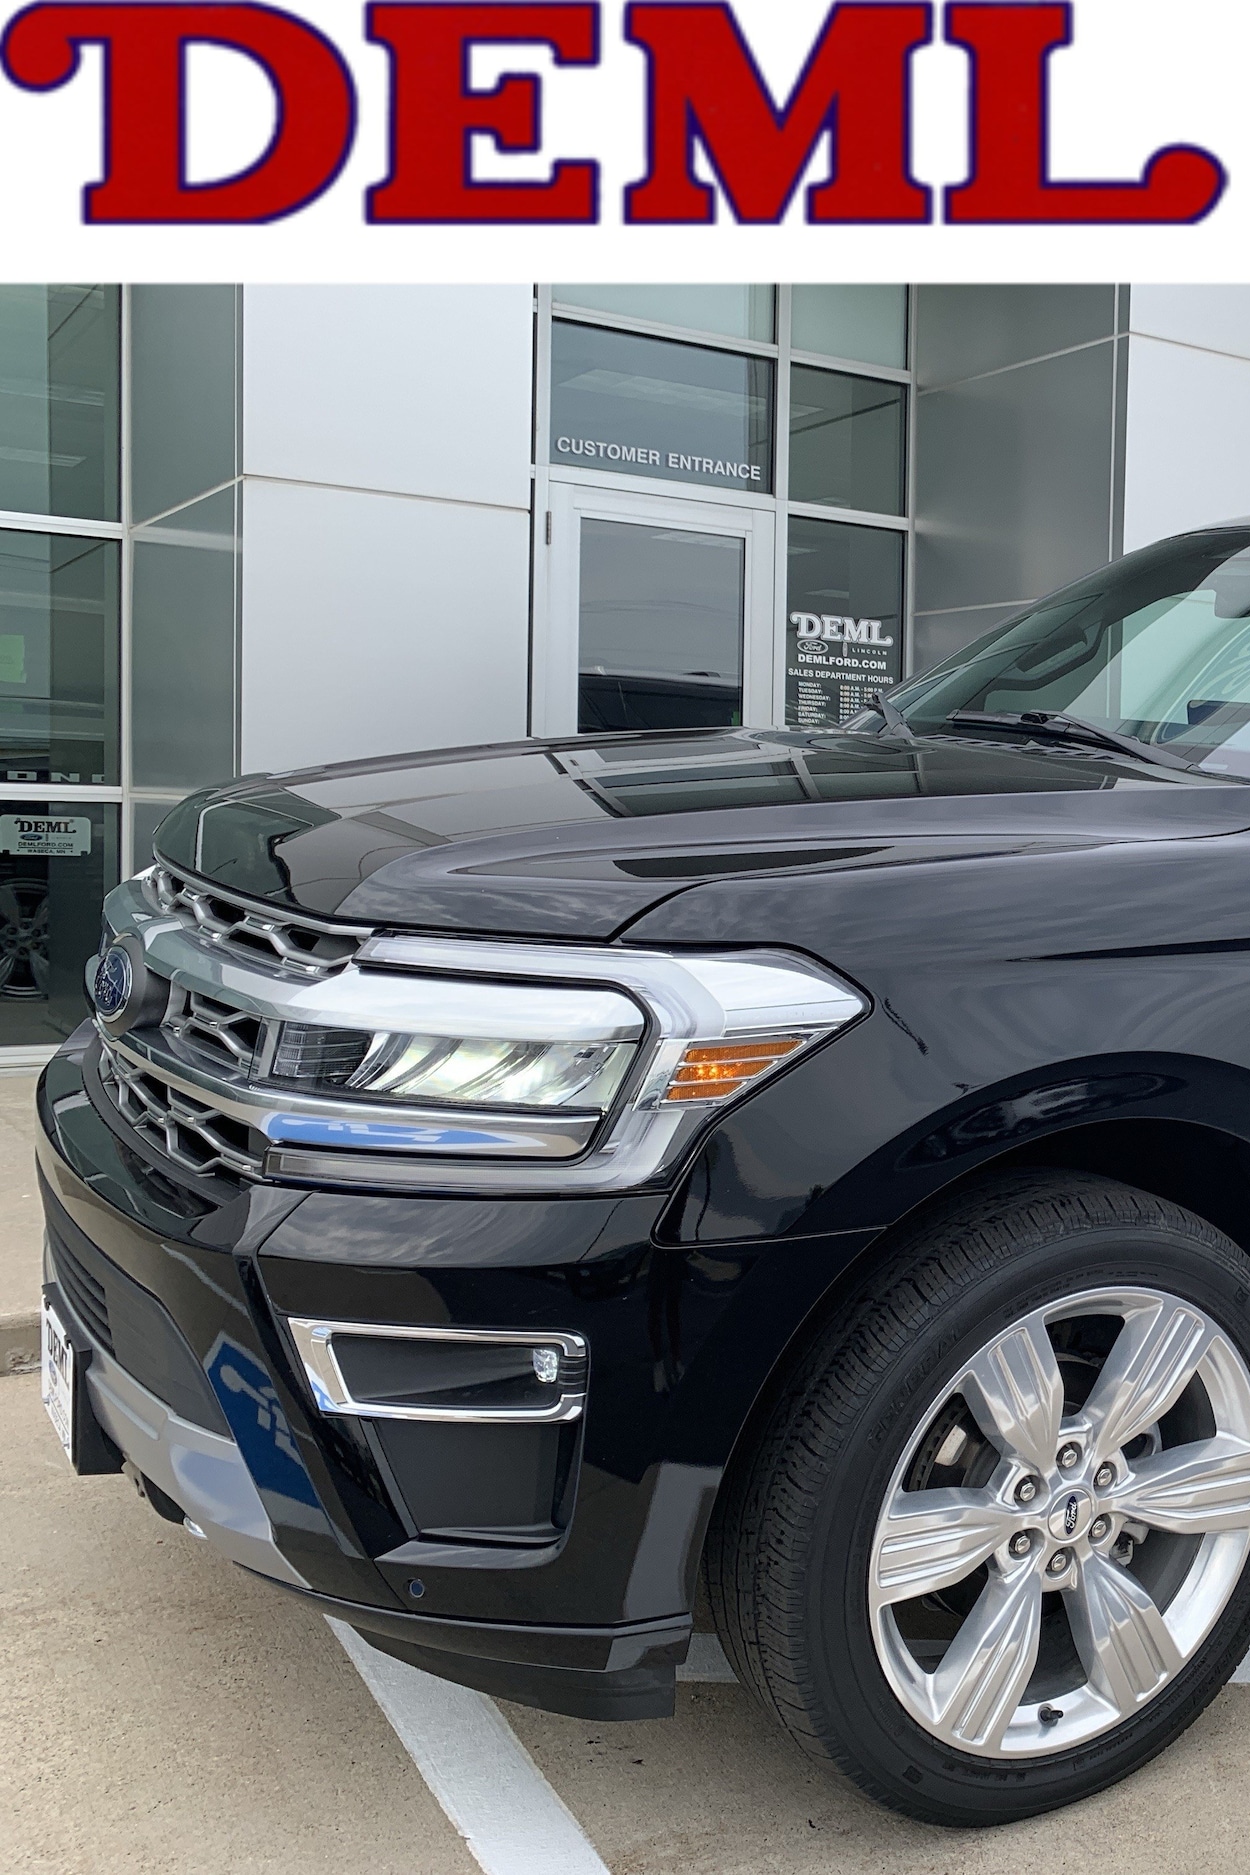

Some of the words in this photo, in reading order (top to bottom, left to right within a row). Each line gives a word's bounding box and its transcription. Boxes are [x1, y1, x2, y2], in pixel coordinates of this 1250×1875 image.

[557, 436, 660, 466] CUSTOMER
[668, 453, 761, 480] ENTRANCE
[790, 611, 893, 647] DEML
[852, 647, 887, 656] LINCOLN
[797, 653, 887, 671] DEMLFORD.COM
[788, 667, 814, 678] SALES
[815, 670, 866, 682] DEPARTMENT
[867, 674, 894, 685] HOURS
[14, 819, 76, 833] DEML
[1065, 1502, 1078, 1529] Ford
